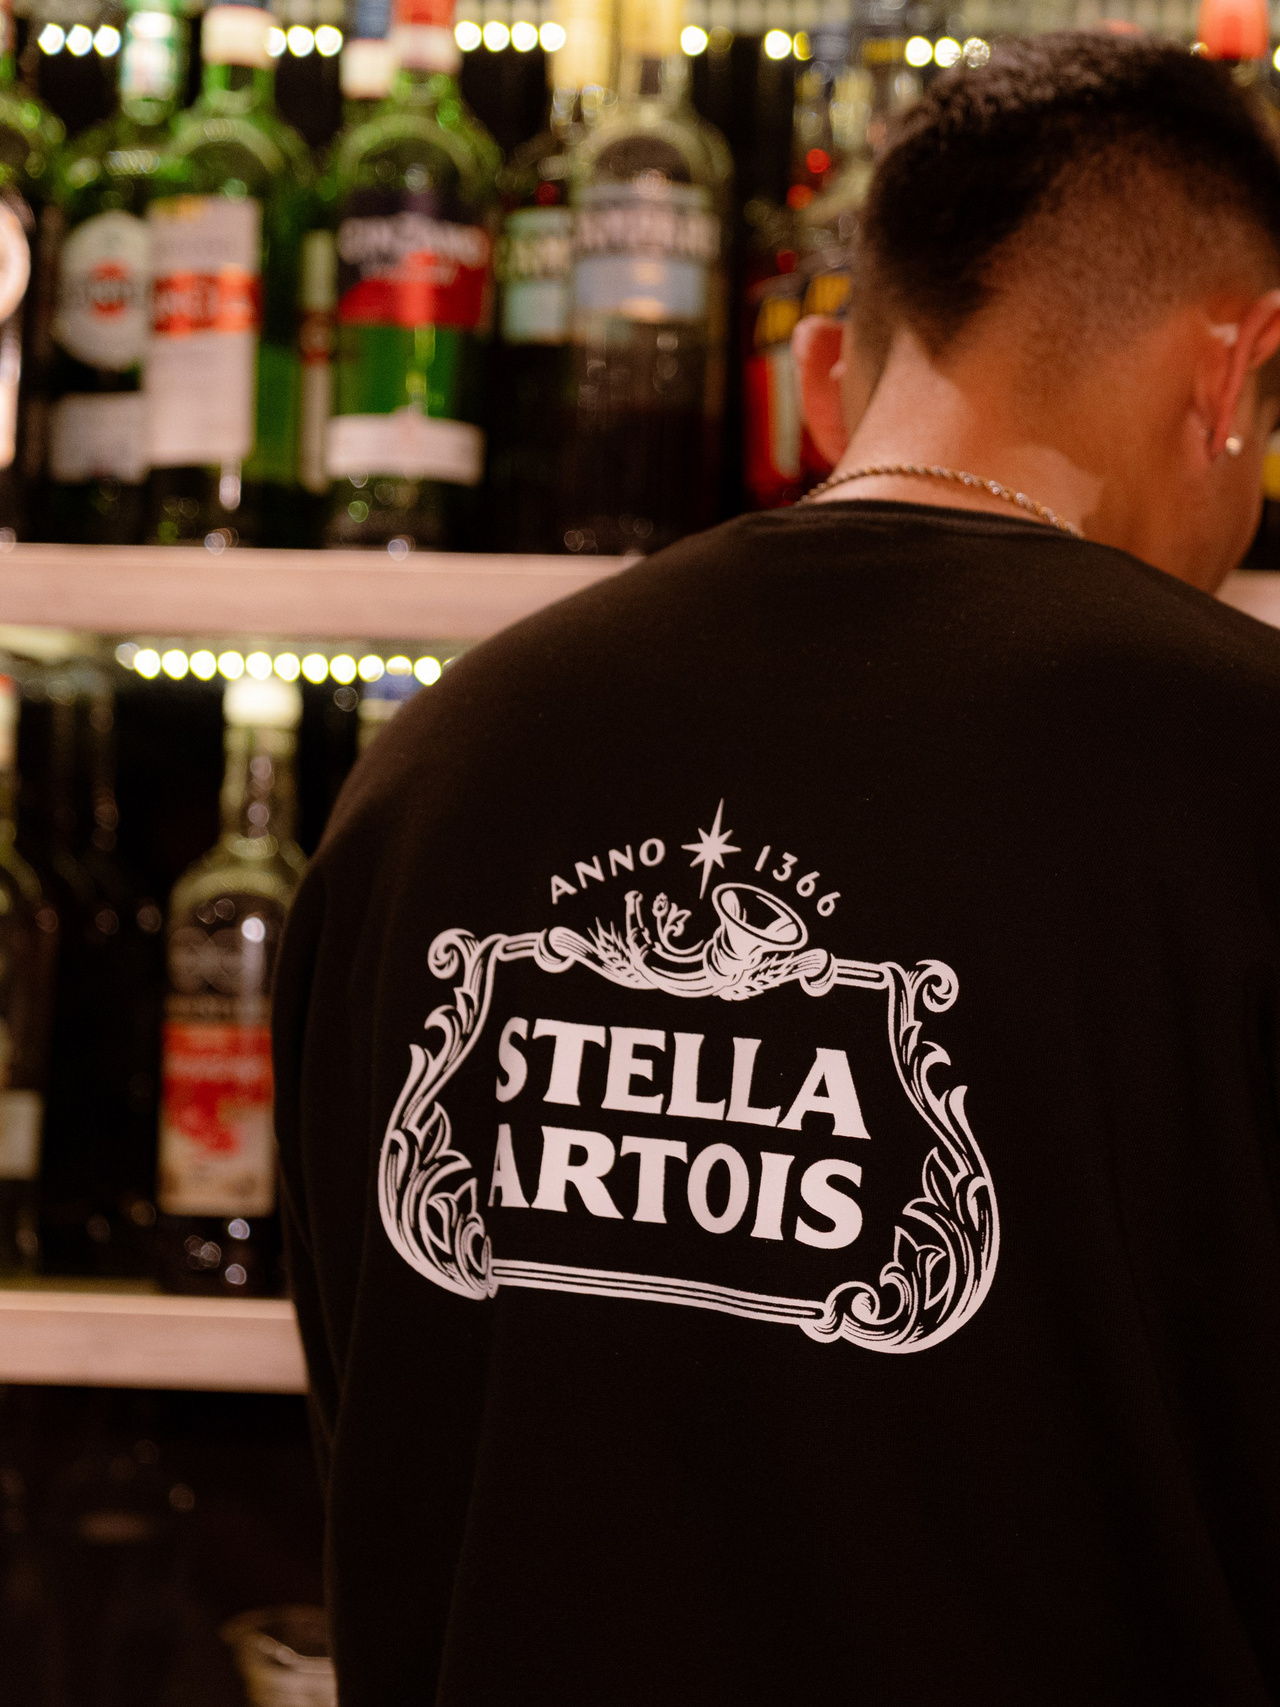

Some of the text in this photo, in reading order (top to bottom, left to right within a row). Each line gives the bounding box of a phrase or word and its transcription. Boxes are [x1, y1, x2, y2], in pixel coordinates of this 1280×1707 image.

[550, 837, 841, 917] ANNO 1366
[495, 1016, 872, 1140] STELLA
[487, 1123, 864, 1250] ARTOIS
